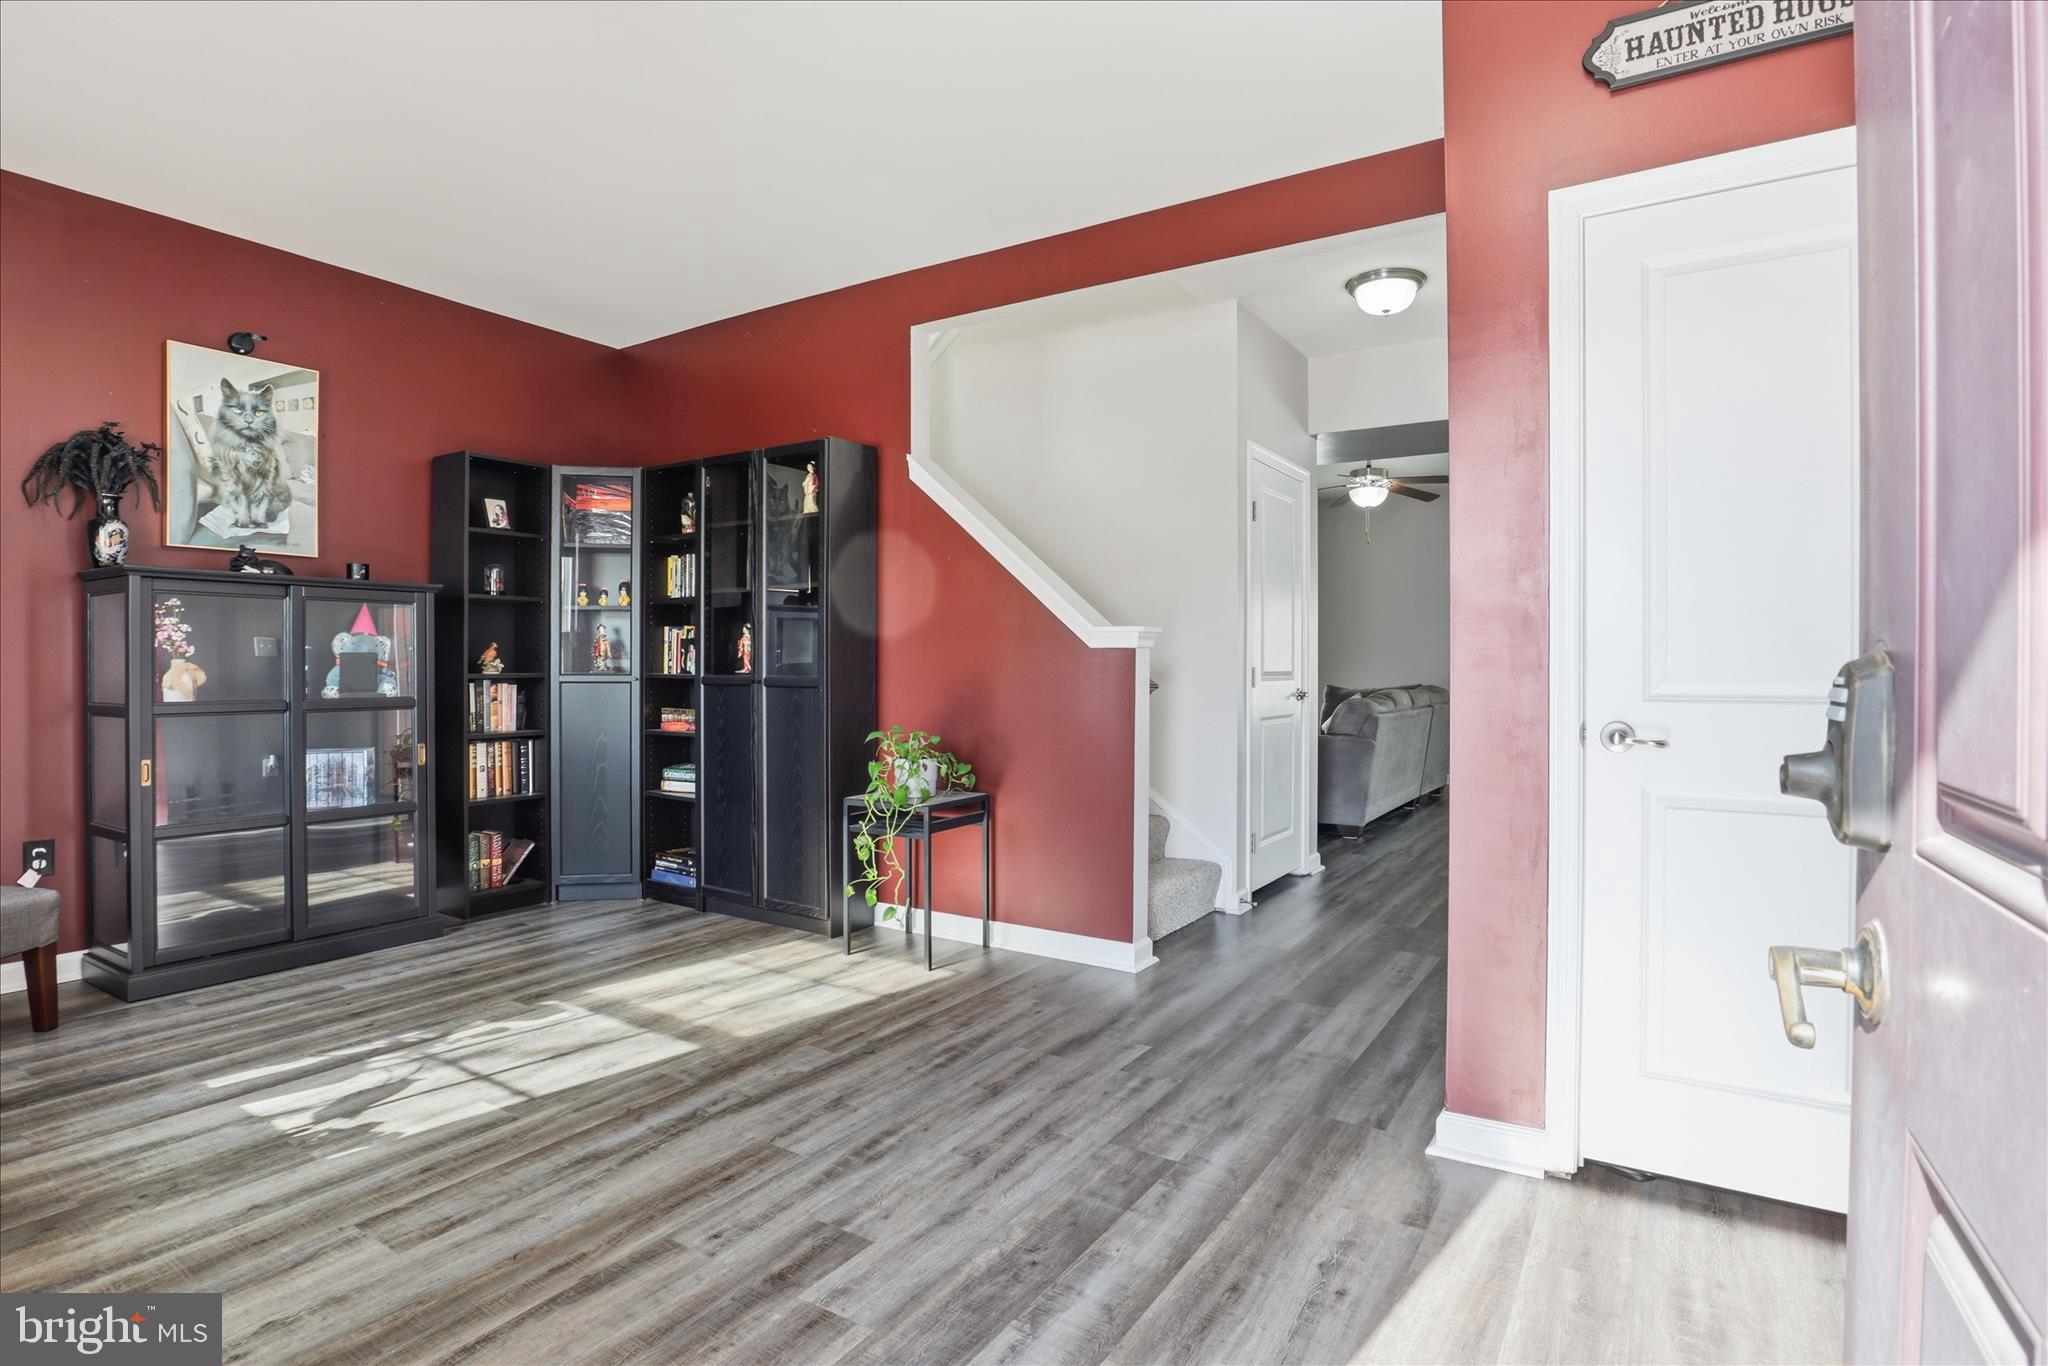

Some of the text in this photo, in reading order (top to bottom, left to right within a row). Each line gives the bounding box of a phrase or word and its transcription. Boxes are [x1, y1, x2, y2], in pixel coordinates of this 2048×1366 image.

[1624, 5, 1764, 62] HAUNTED
[1656, 13, 1844, 68] ENTER AT YOUR OWN RISK
